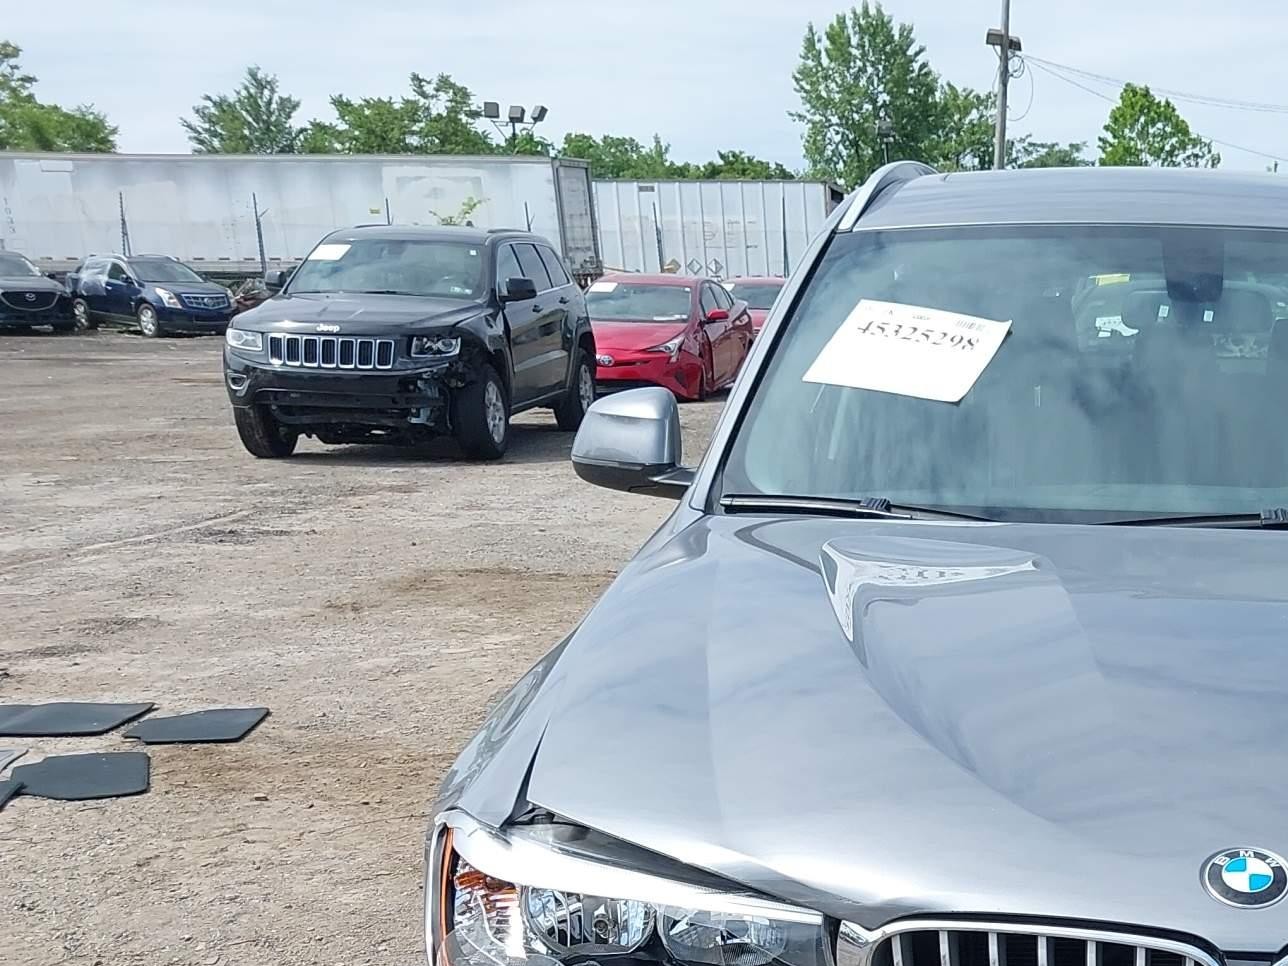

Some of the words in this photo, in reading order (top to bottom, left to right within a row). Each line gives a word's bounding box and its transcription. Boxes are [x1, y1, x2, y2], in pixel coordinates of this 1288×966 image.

[316, 323, 341, 333] Jeep
[857, 320, 980, 351] 45325298
[1214, 849, 1281, 868] BMW
